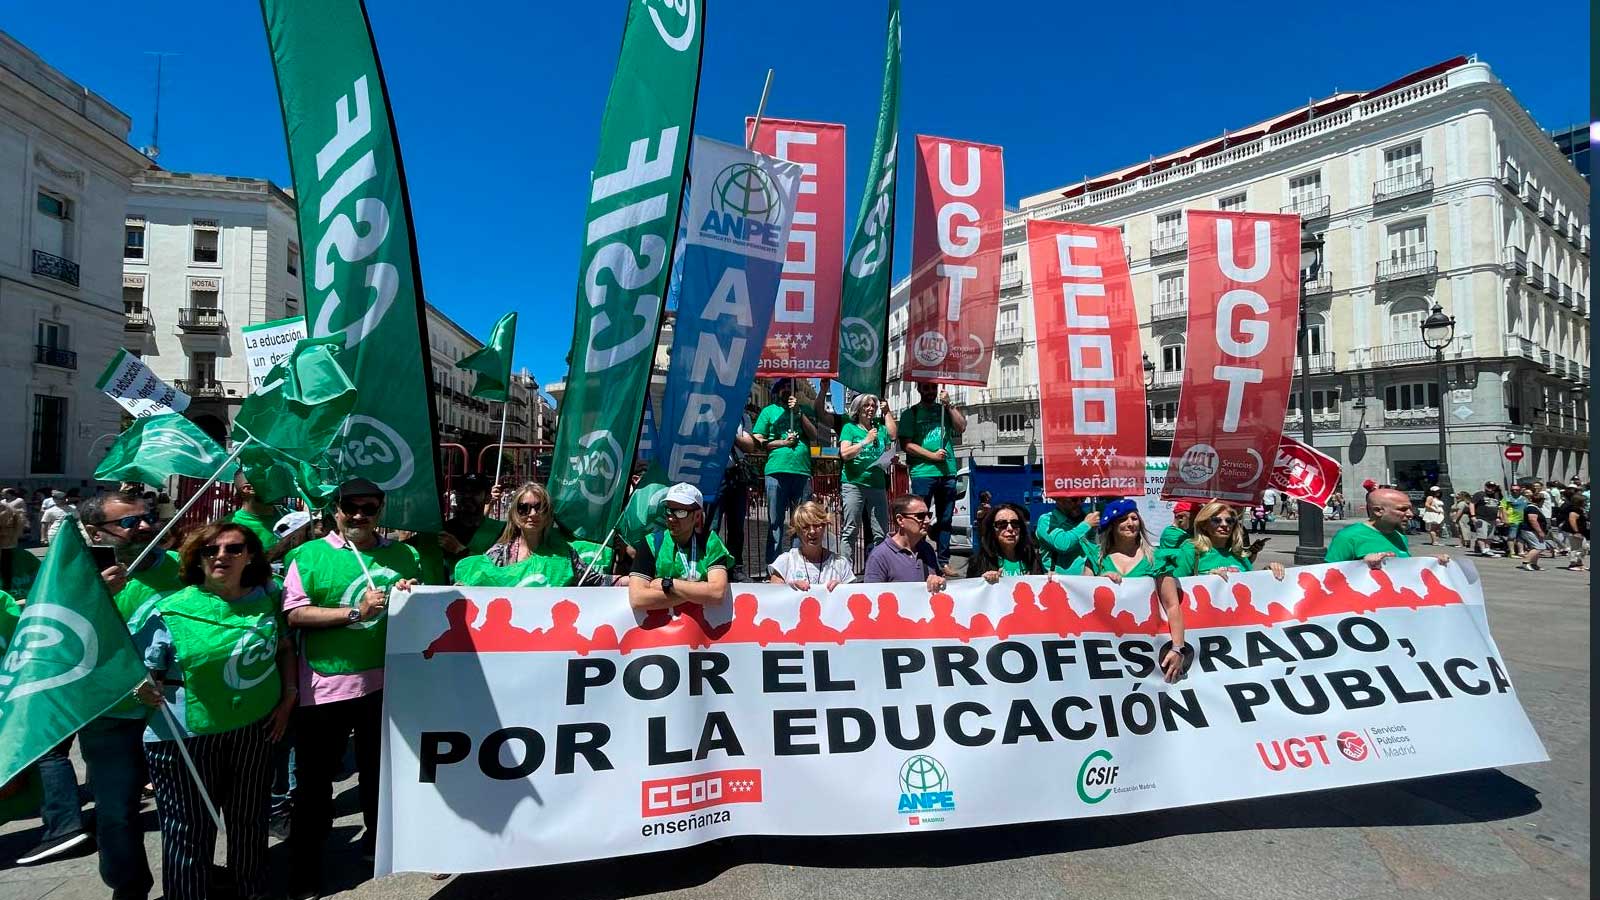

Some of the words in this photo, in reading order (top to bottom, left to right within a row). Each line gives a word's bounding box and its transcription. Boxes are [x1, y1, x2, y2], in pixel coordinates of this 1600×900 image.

[701, 209, 781, 247] ANPE
[936, 142, 981, 321] UGT
[1056, 234, 1117, 435] CCOO
[1213, 218, 1271, 433] UGT
[245, 336, 257, 349] La
[920, 335, 943, 352] UGT
[253, 356, 265, 367] un
[668, 267, 753, 484] ANPE
[108, 387, 122, 398] La
[128, 396, 139, 408] un
[1187, 450, 1215, 468] UGT
[1221, 459, 1252, 468] Servicios
[1274, 448, 1319, 485] UGT
[1055, 473, 1136, 490] enseñanza
[566, 651, 733, 706] POR
[762, 649, 855, 693] EL
[881, 616, 1416, 690] PROFESORADO,
[418, 722, 614, 784] POR
[647, 711, 745, 766] LA
[773, 682, 1210, 756] EDUCACIÓN
[1225, 656, 1512, 724] PÚBLICA
[1371, 724, 1407, 735] Servicios
[1376, 734, 1410, 745] Públicos
[1256, 735, 1331, 772] UGT
[1383, 745, 1416, 759] Madrid
[1086, 766, 1119, 786] CSIF
[648, 777, 723, 810] CCOO
[1113, 785, 1138, 793] Educación
[1139, 782, 1157, 790] Madrid
[898, 791, 955, 810] ANPE
[641, 809, 731, 837] enseñanza
